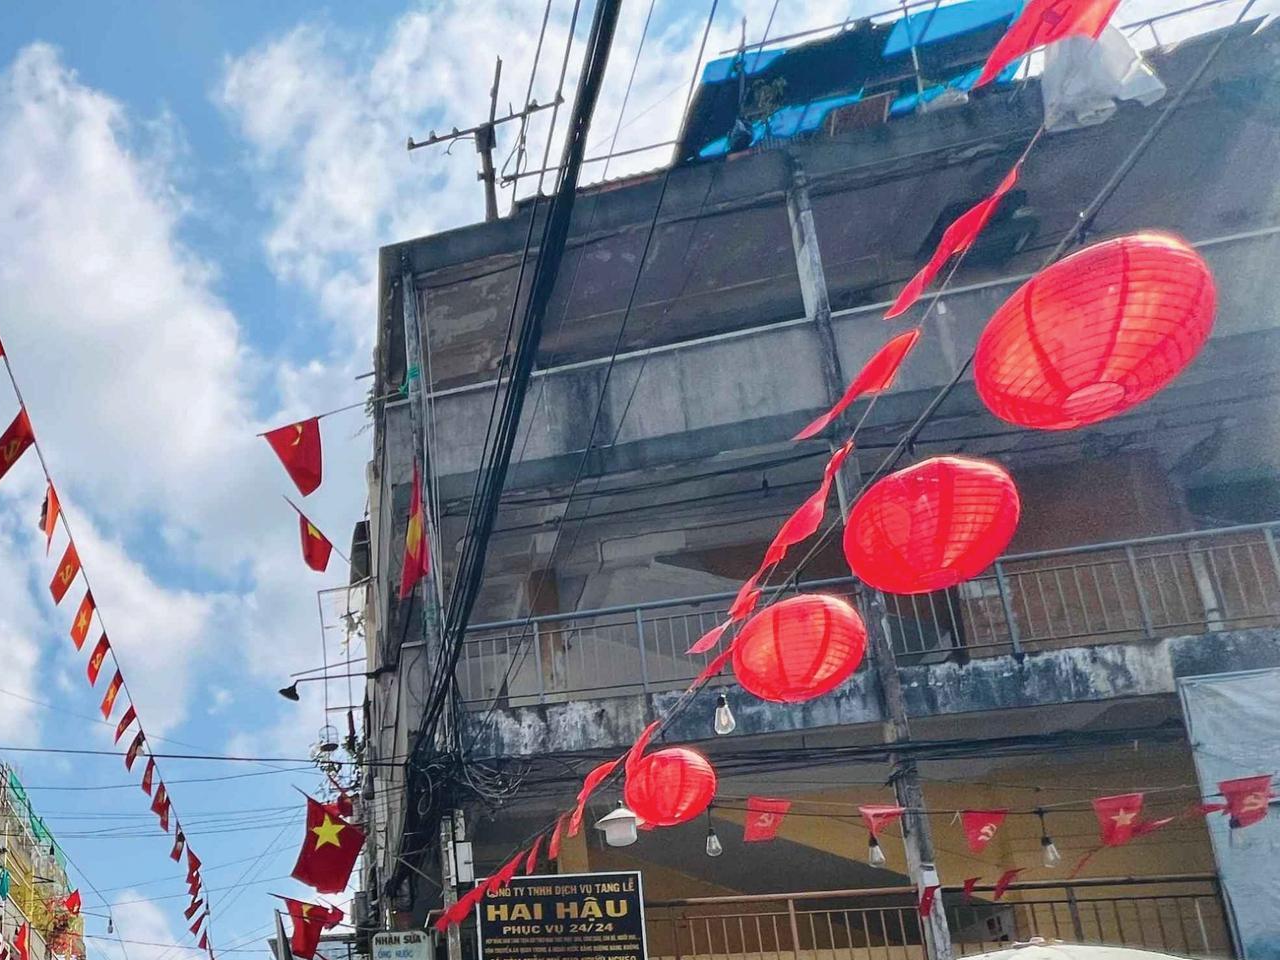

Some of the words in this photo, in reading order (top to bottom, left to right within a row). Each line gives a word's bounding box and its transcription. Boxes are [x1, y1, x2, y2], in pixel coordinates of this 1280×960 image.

[514, 887, 525, 897] TY
[528, 886, 553, 897] TNHH
[554, 885, 578, 898] DỊCH
[579, 884, 593, 898] VỤ
[595, 882, 620, 894] TANG
[622, 877, 635, 893] LỄ
[487, 903, 543, 922] HAI
[556, 896, 628, 922] HẬU
[502, 924, 541, 936] PHỤC
[545, 923, 564, 935] VỤ
[569, 922, 614, 934] 24/24
